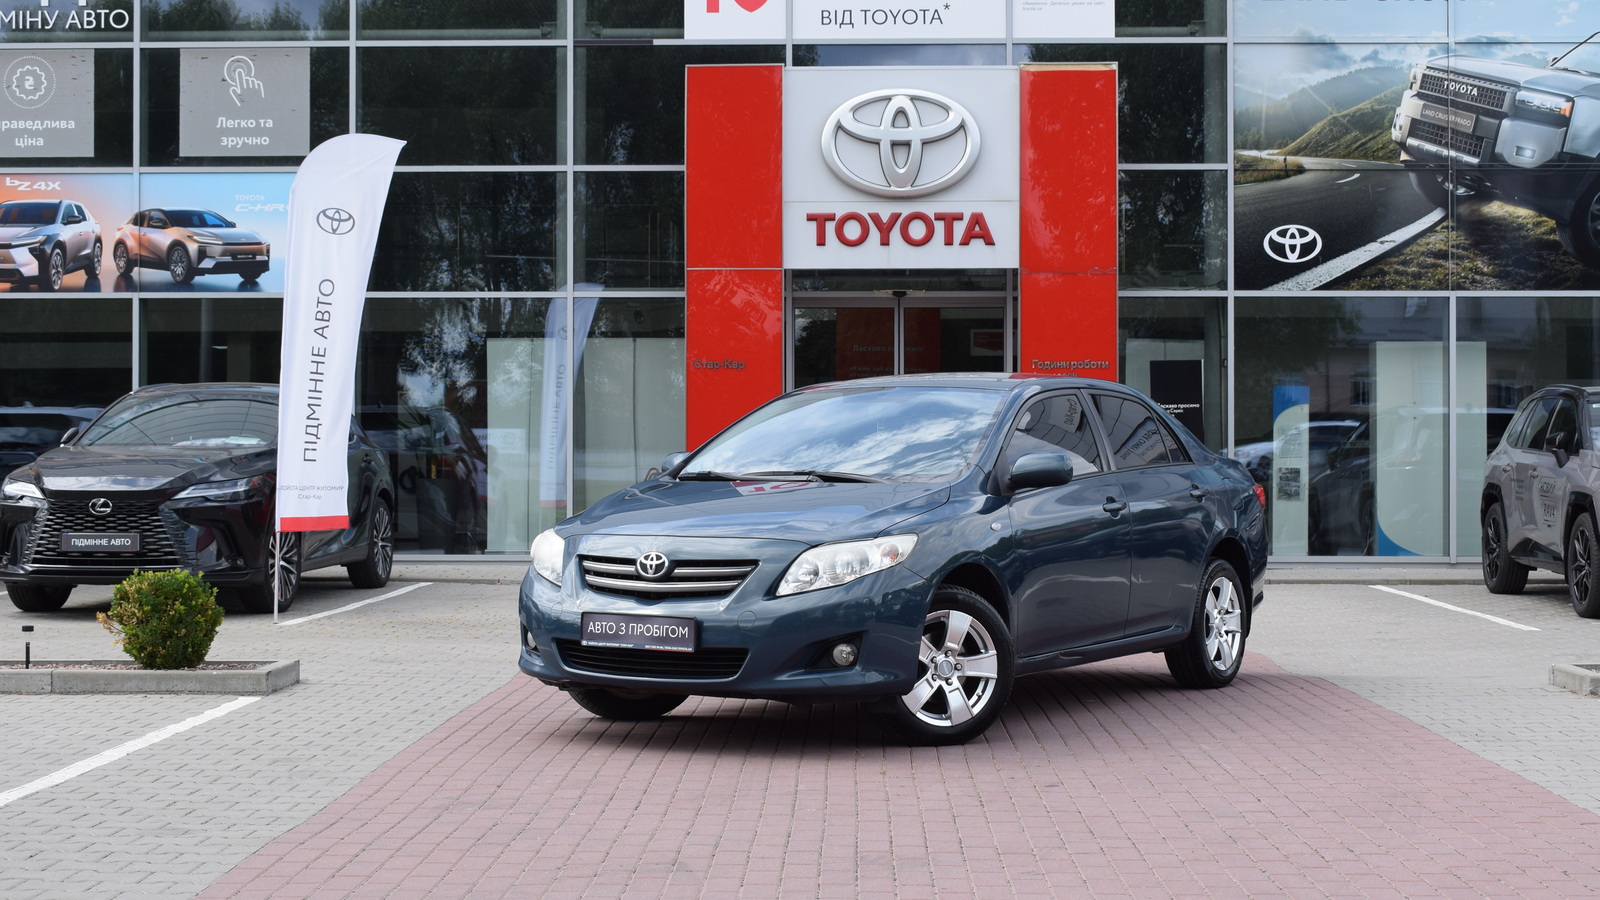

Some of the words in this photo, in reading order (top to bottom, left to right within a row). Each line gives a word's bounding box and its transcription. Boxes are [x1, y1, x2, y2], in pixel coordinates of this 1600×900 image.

[65, 9, 129, 29] АВТО
[820, 9, 854, 28] ВІД
[1443, 81, 1478, 96] TOYOTA
[1422, 109, 1435, 117] LAND
[0, 119, 75, 132] раведлива
[216, 117, 256, 128] Легко
[259, 119, 273, 128] та
[15, 134, 44, 148] ціна
[220, 135, 270, 147] зручно
[806, 211, 996, 247] TOYOTA
[313, 278, 335, 339] АВТО
[693, 359, 745, 371] Стар-Кар
[1031, 360, 1069, 370] Години
[1070, 359, 1109, 370] роботи
[303, 346, 327, 462] ПІДМІННЕ
[71, 538, 109, 547] ПІДМІННЕ
[110, 538, 131, 546] АВТО
[587, 621, 616, 635] АВТО
[628, 623, 689, 639] ПРОБІГОМ
